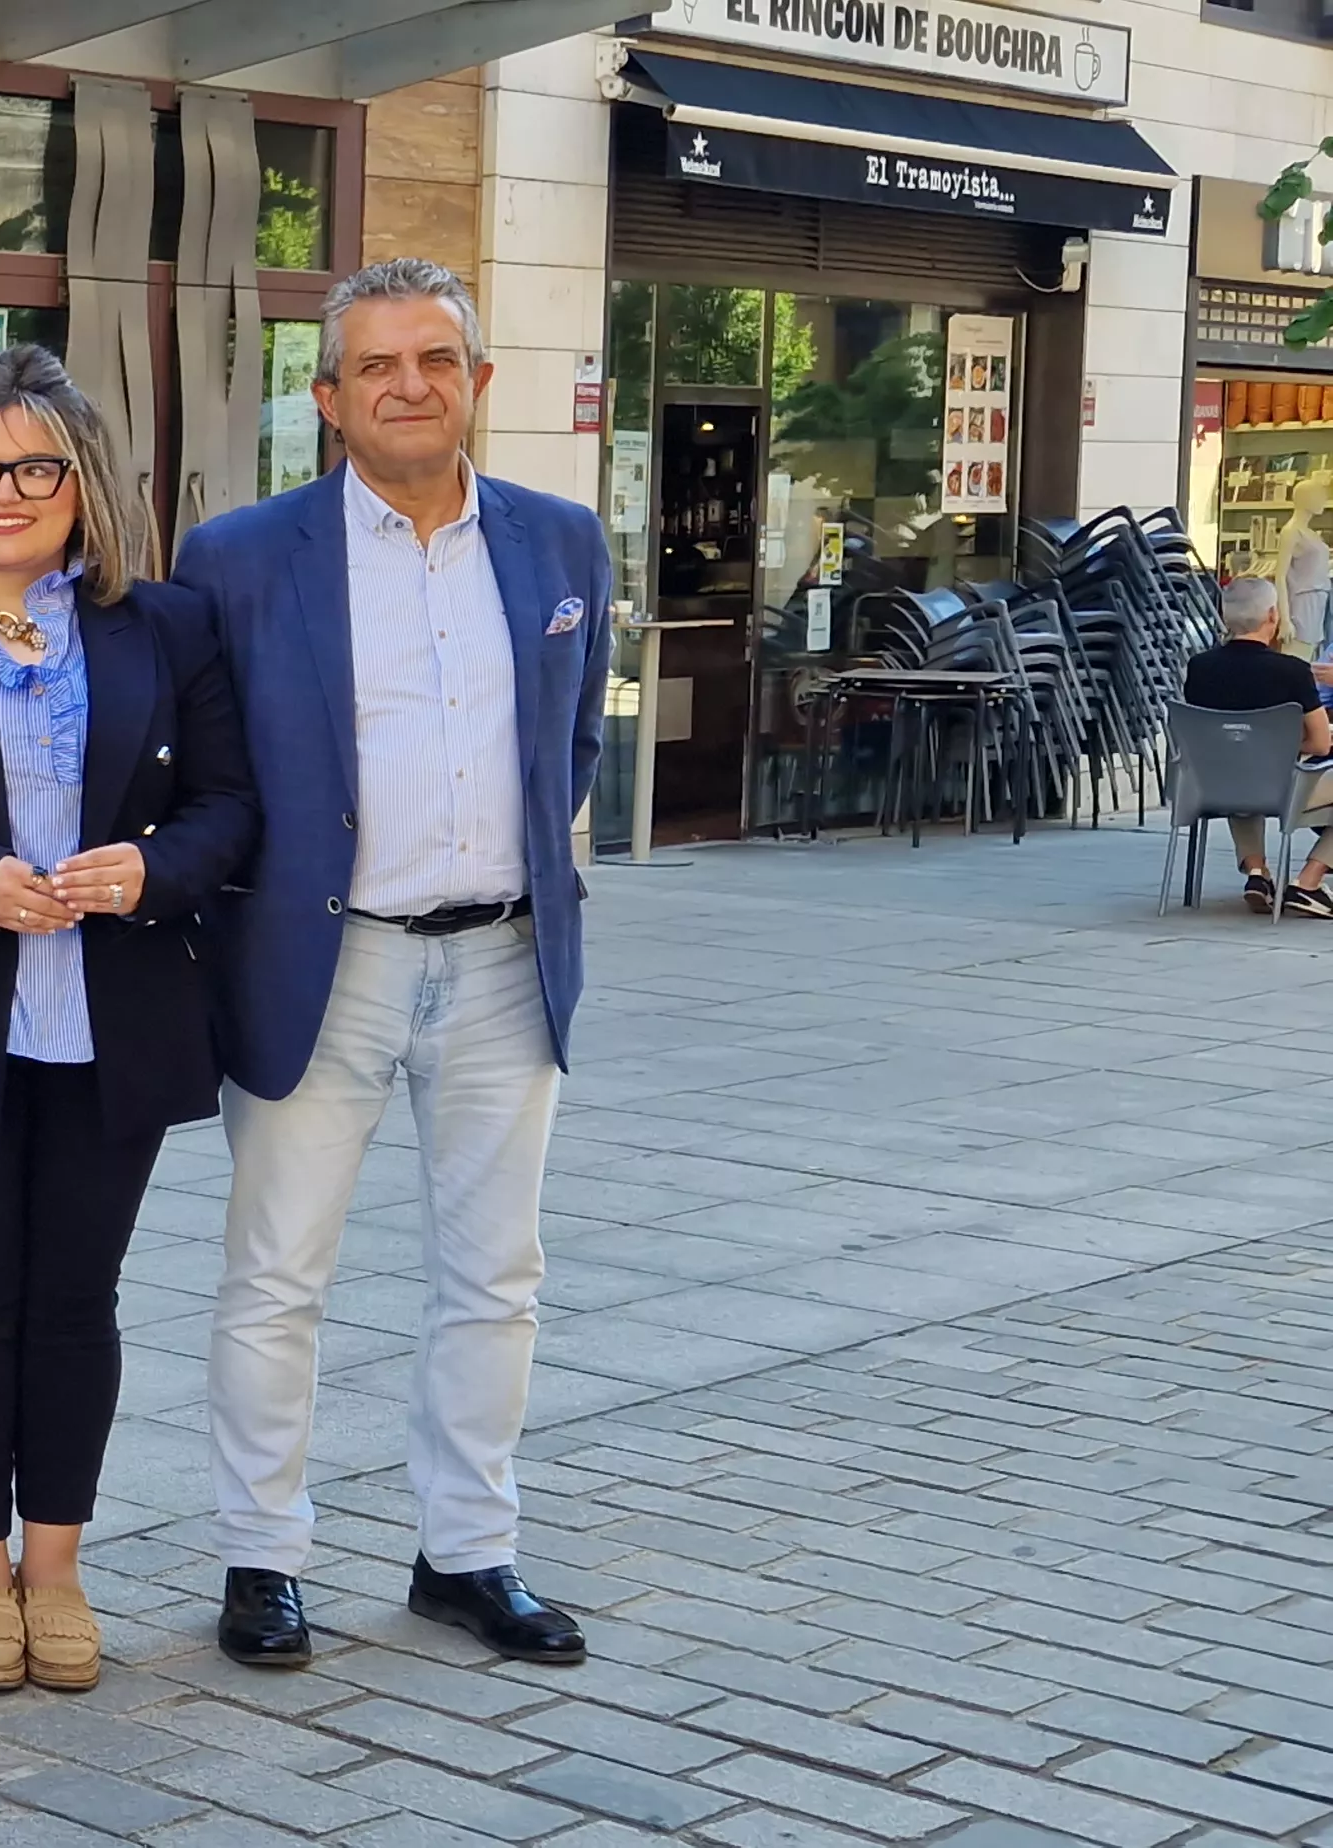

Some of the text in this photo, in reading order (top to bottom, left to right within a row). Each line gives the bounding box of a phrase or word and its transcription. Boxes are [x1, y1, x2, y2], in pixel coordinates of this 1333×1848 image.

[894, 6, 929, 53] DE
[936, 14, 1063, 78] BOUCHRA
[866, 155, 1015, 202] El Tramoyista...
